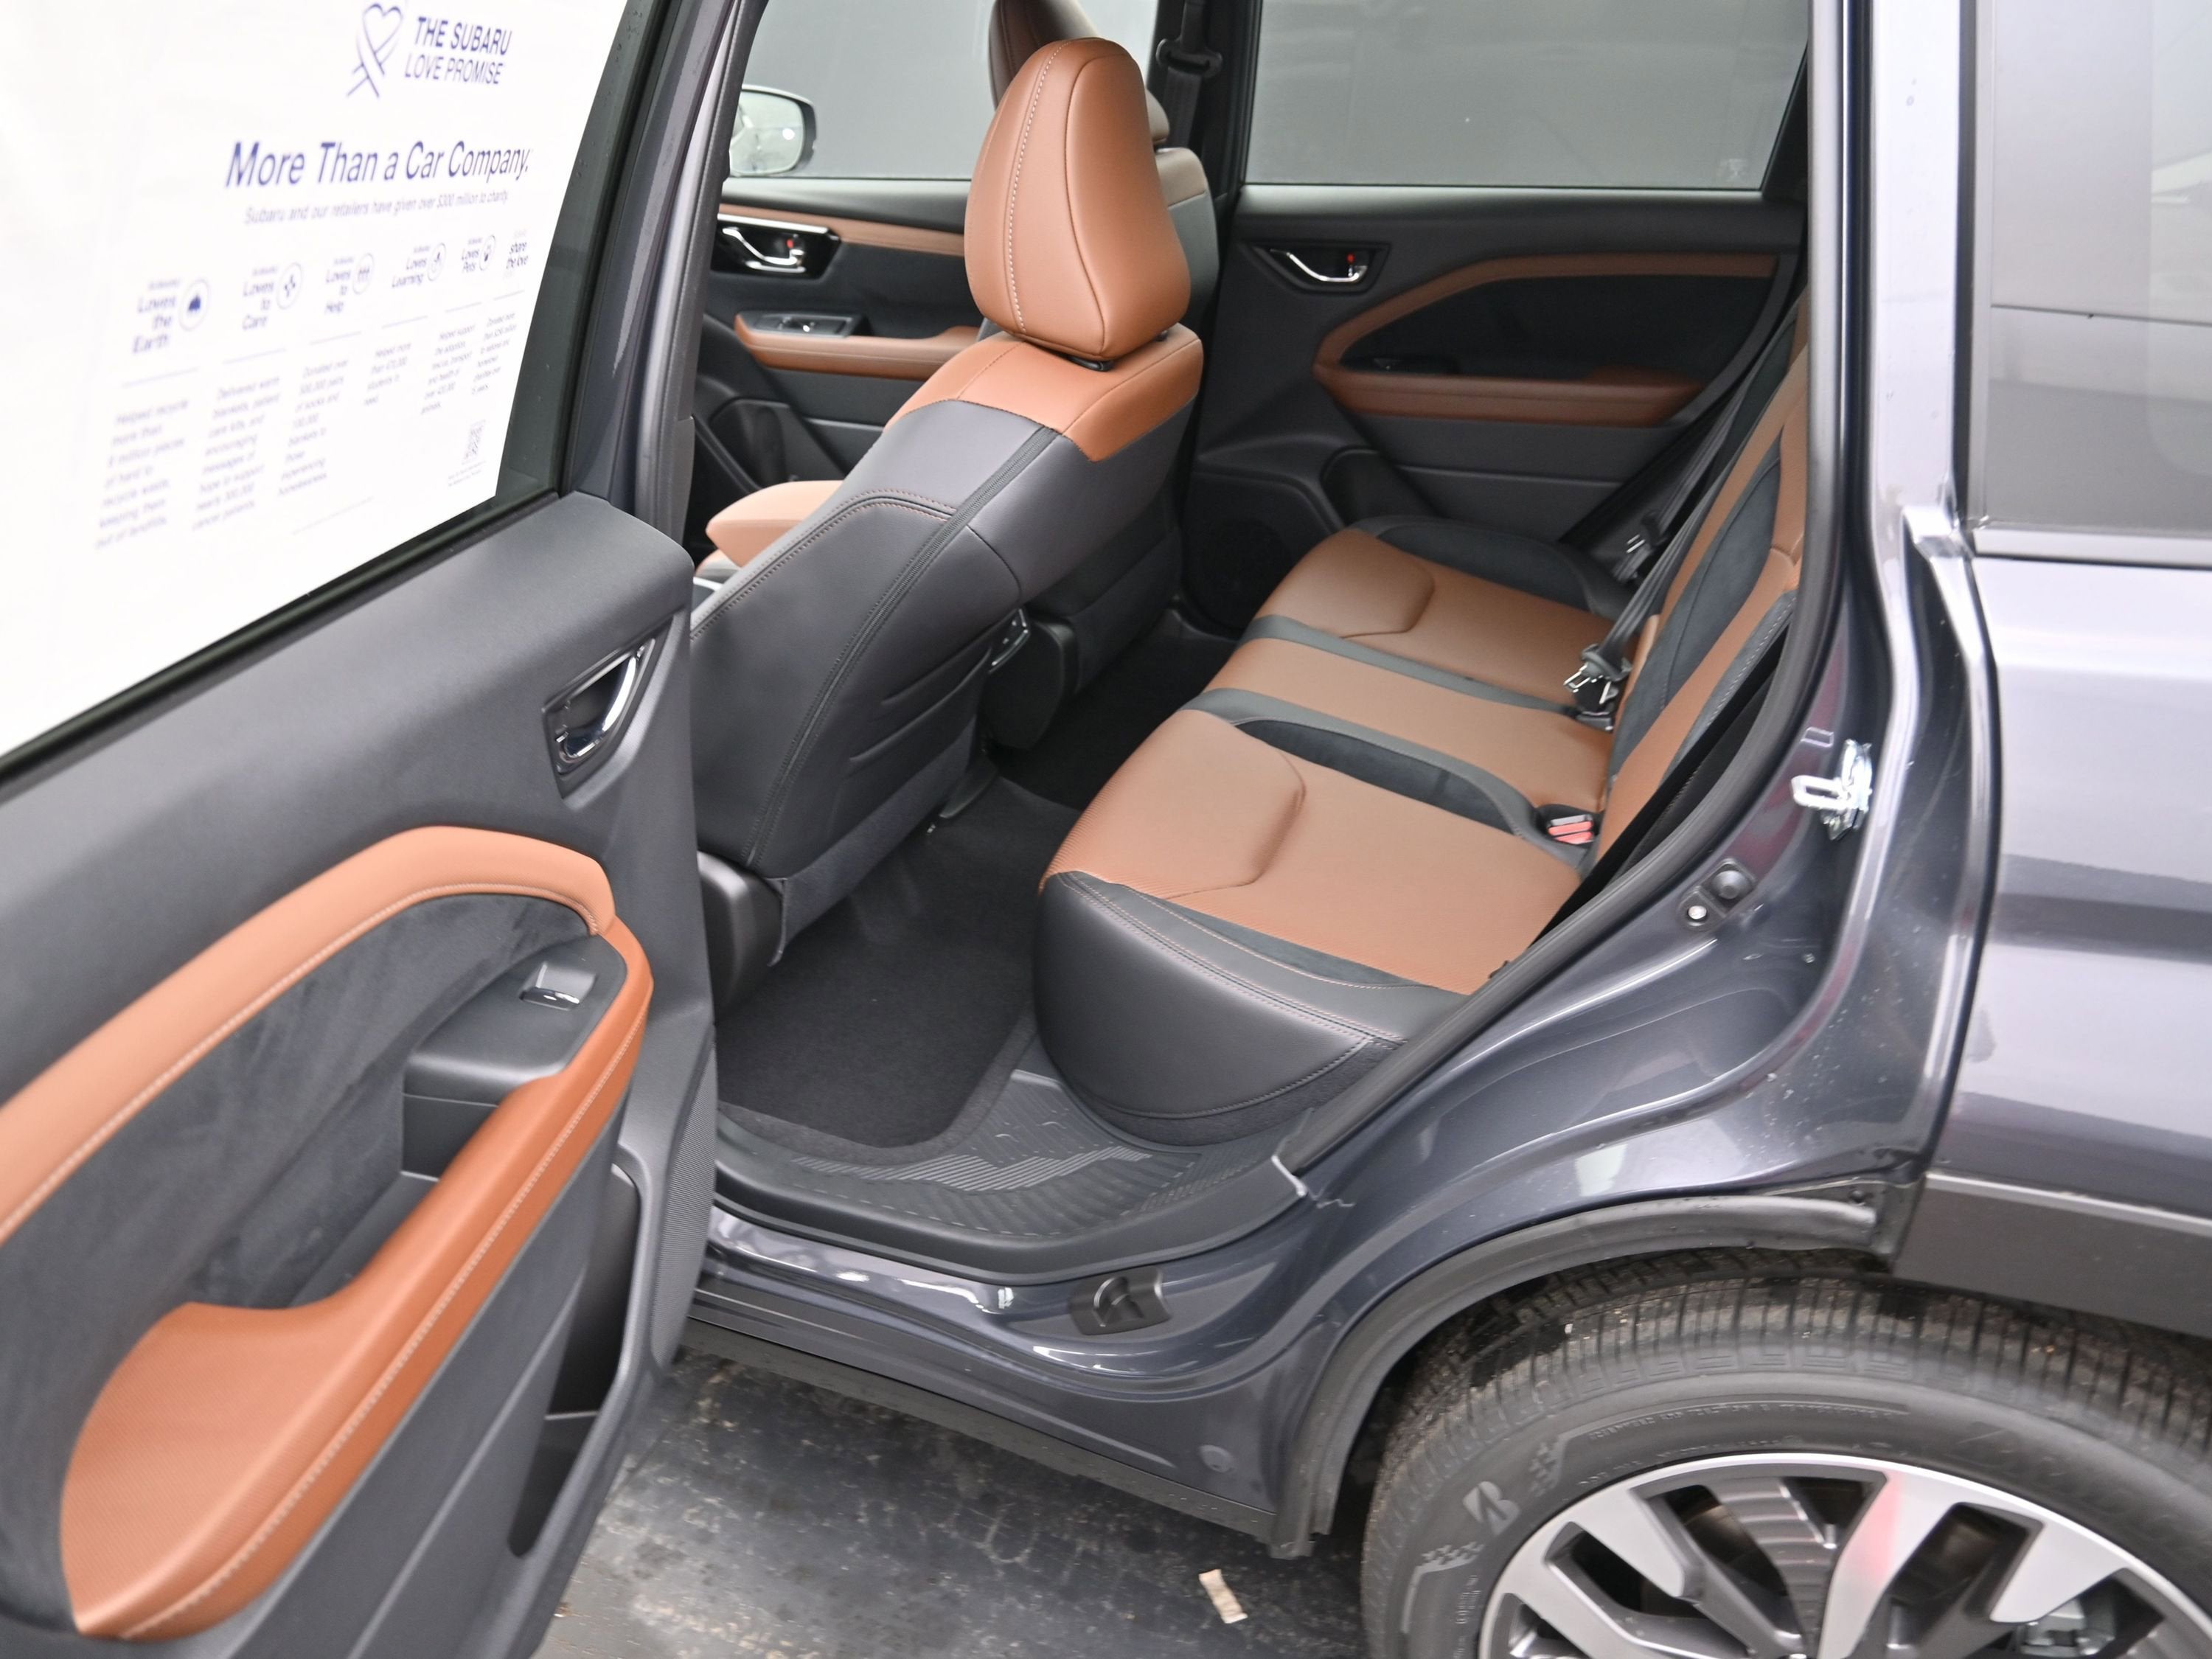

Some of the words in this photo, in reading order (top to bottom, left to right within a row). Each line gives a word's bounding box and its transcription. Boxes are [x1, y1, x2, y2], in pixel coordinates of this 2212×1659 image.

[415, 17, 448, 47] THE
[451, 22, 512, 55] SUBARU
[405, 53, 444, 80] LOVE
[445, 58, 504, 84] PROMISE
[226, 142, 305, 187] More
[318, 142, 378, 183] Than
[383, 151, 399, 181] a
[406, 141, 445, 179] Car
[448, 141, 530, 183] Company.
[244, 205, 285, 224] Subaru
[288, 204, 308, 221] and
[311, 206, 329, 220] our
[332, 202, 369, 218] retailers
[371, 201, 392, 215] have
[394, 197, 417, 216] given
[418, 198, 436, 209] over
[462, 248, 479, 261] Loves
[509, 242, 527, 255] share
[406, 257, 427, 270] Loves
[462, 261, 477, 273] Pets
[506, 258, 516, 270] the
[517, 255, 529, 266] love
[326, 269, 351, 284] Loves
[392, 274, 423, 288] Learning
[243, 281, 274, 296] Loves
[136, 296, 175, 313] Loves
[260, 297, 271, 310] to
[324, 299, 344, 316] Help
[153, 314, 172, 330] the
[242, 314, 268, 330] Care
[133, 334, 167, 355] Earth
